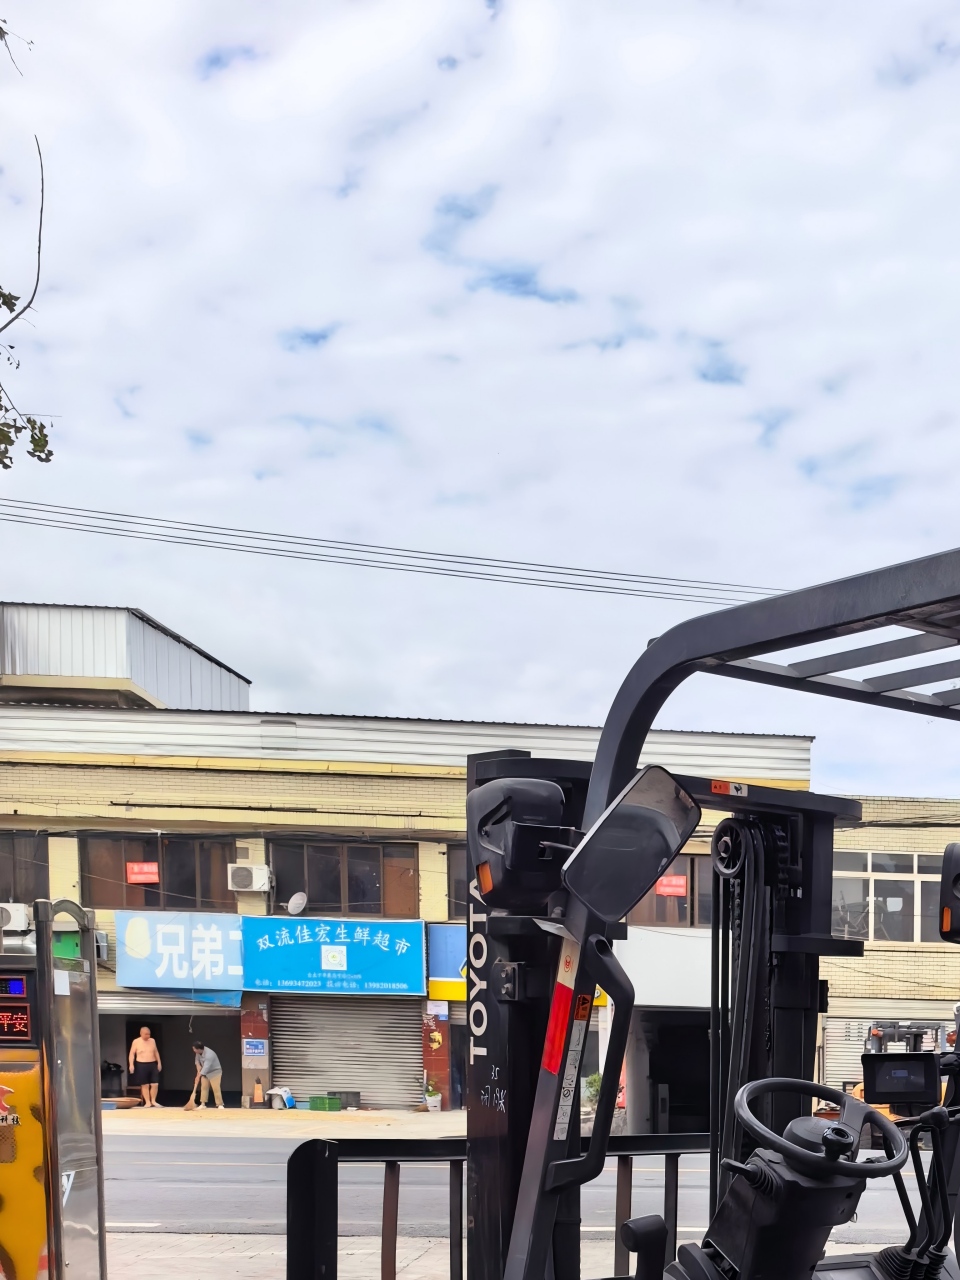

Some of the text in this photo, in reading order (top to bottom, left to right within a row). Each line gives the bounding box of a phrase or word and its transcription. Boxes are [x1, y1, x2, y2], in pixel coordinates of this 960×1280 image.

[256, 923, 411, 956] 双流佳宏生鲜超市
